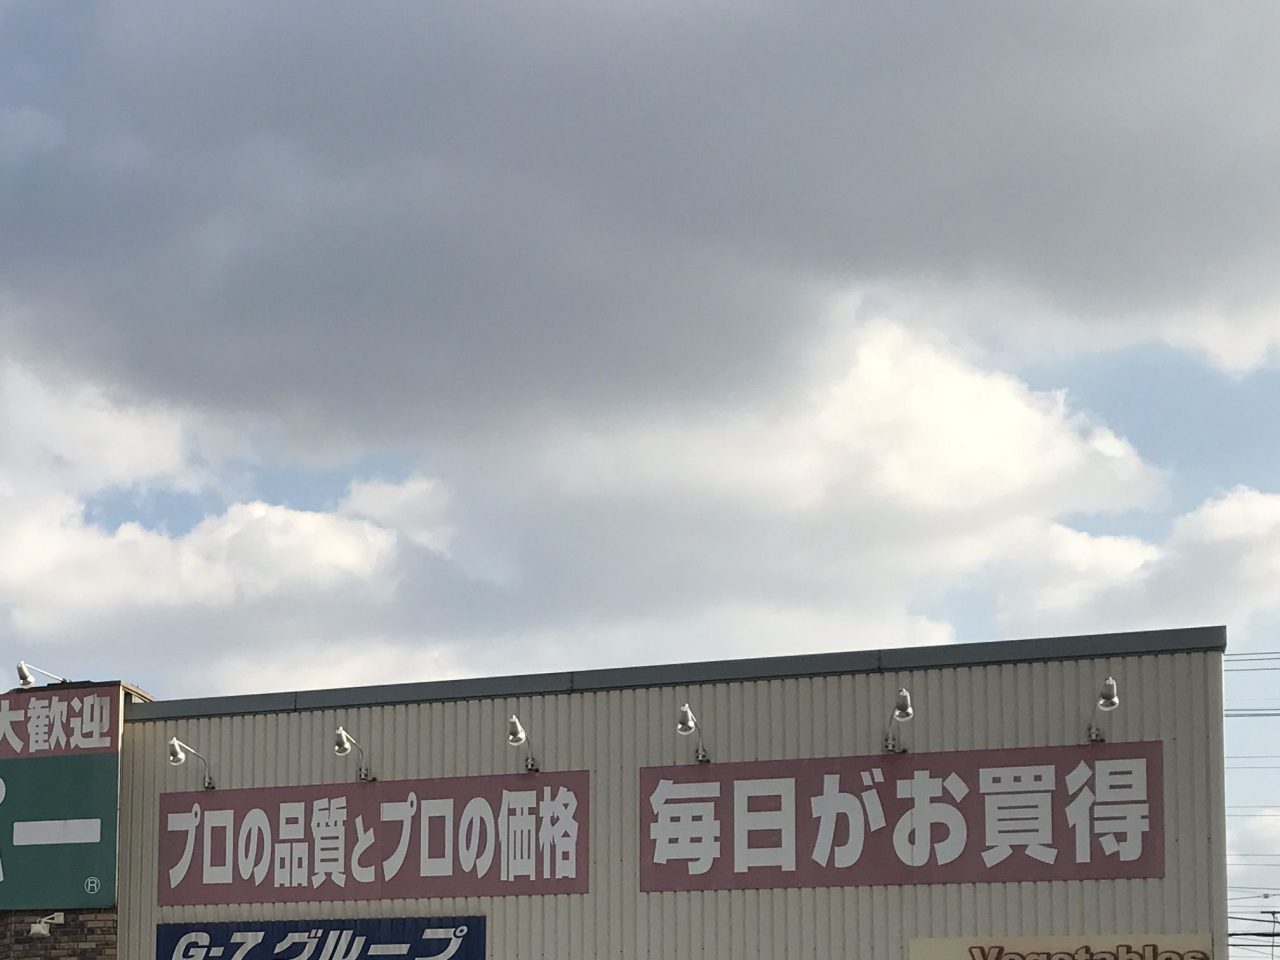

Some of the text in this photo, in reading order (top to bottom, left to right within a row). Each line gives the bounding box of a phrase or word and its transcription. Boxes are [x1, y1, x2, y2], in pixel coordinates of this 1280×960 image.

[166, 784, 578, 890] プロの品質とプロの価格
[650, 758, 1150, 875] 毎日がお買得
